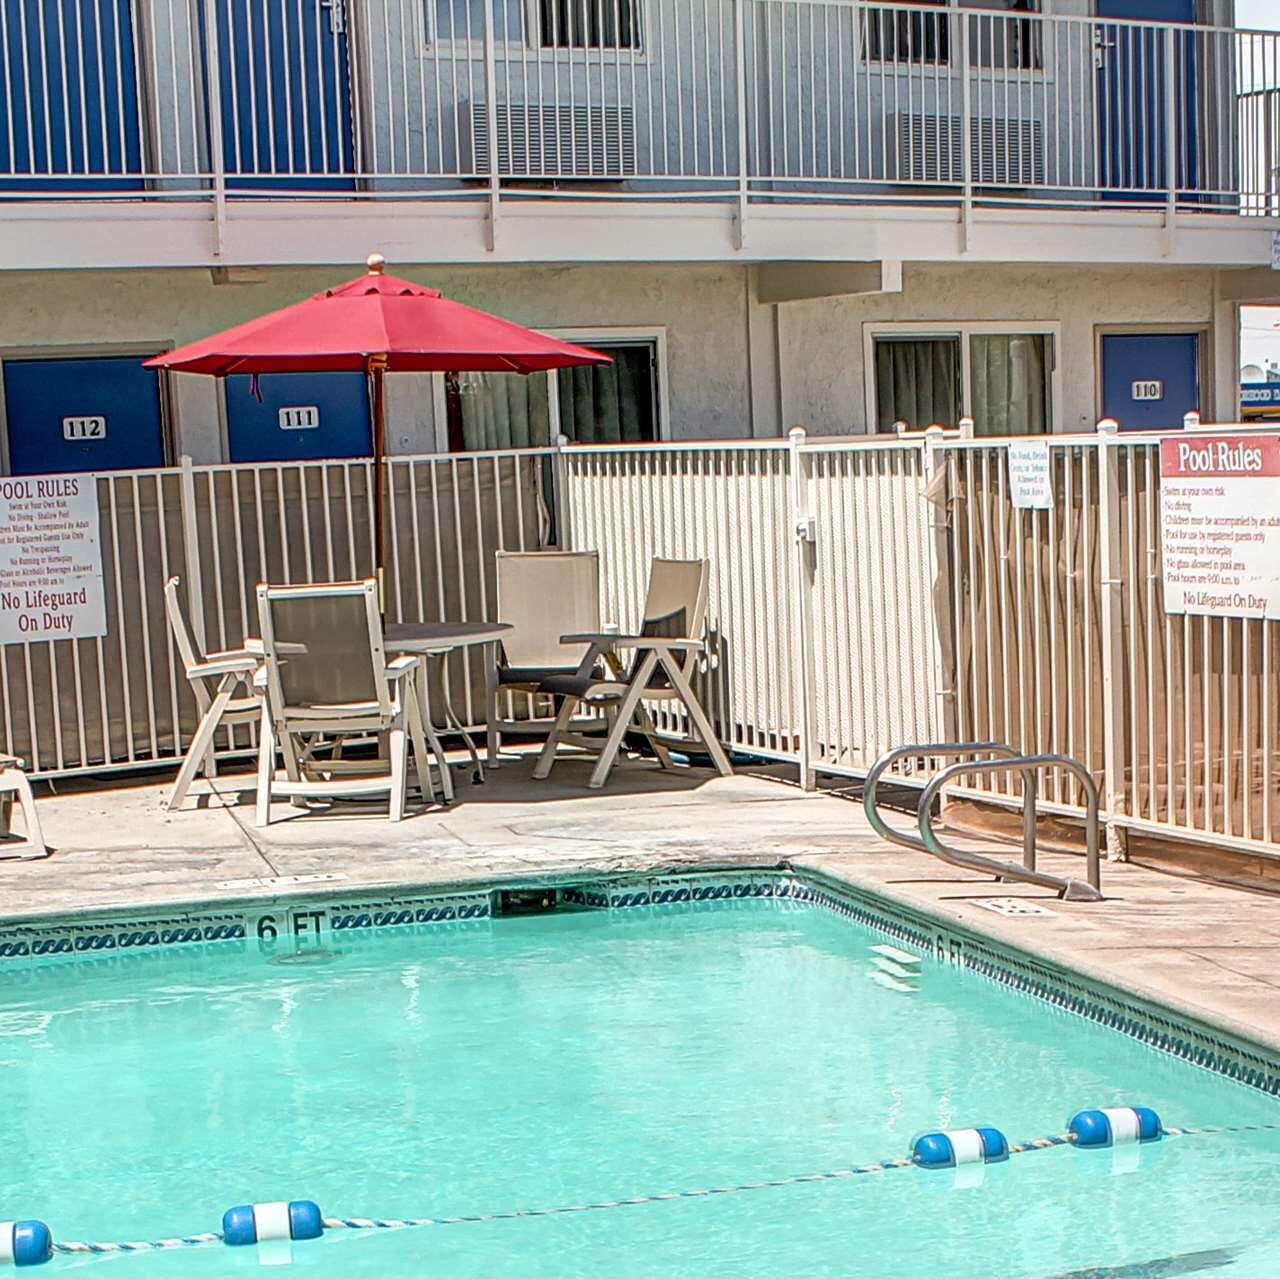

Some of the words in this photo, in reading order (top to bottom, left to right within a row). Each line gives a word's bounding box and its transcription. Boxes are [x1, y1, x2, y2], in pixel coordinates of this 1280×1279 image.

[1135, 383, 1157, 398] 110
[68, 419, 100, 437] 112
[285, 410, 312, 426] 111
[1178, 441, 1215, 472] Pool
[1216, 441, 1263, 472] Rules
[37, 478, 79, 498] RULES
[0, 591, 20, 610] No
[25, 587, 87, 611] Lifeguard
[1183, 591, 1196, 606] No
[1197, 591, 1232, 610] Lifeguard
[1233, 593, 1247, 609] On
[1248, 594, 1268, 611] Duty
[18, 613, 38, 632] On
[43, 611, 73, 632] Duty
[257, 914, 277, 942] 6
[293, 910, 325, 937] FT
